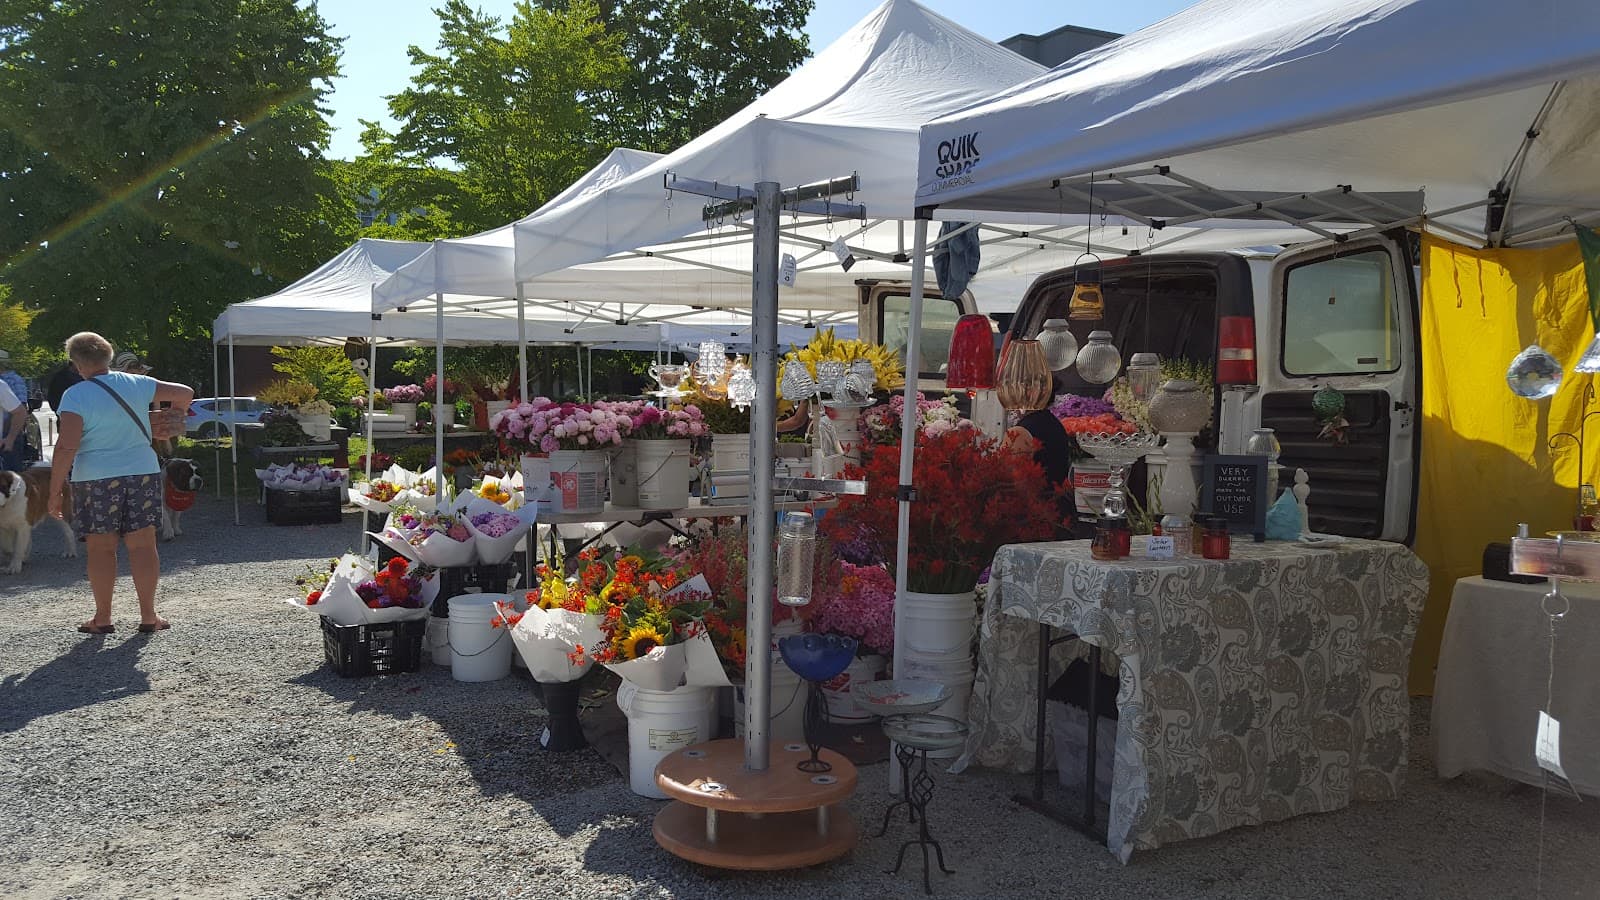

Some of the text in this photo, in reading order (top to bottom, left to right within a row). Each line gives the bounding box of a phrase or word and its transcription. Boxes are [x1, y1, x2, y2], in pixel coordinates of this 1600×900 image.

[938, 131, 979, 164] QUIK
[1221, 467, 1248, 476] VERY
[1216, 495, 1252, 503] OUTDOOR
[1223, 503, 1245, 514] USE
